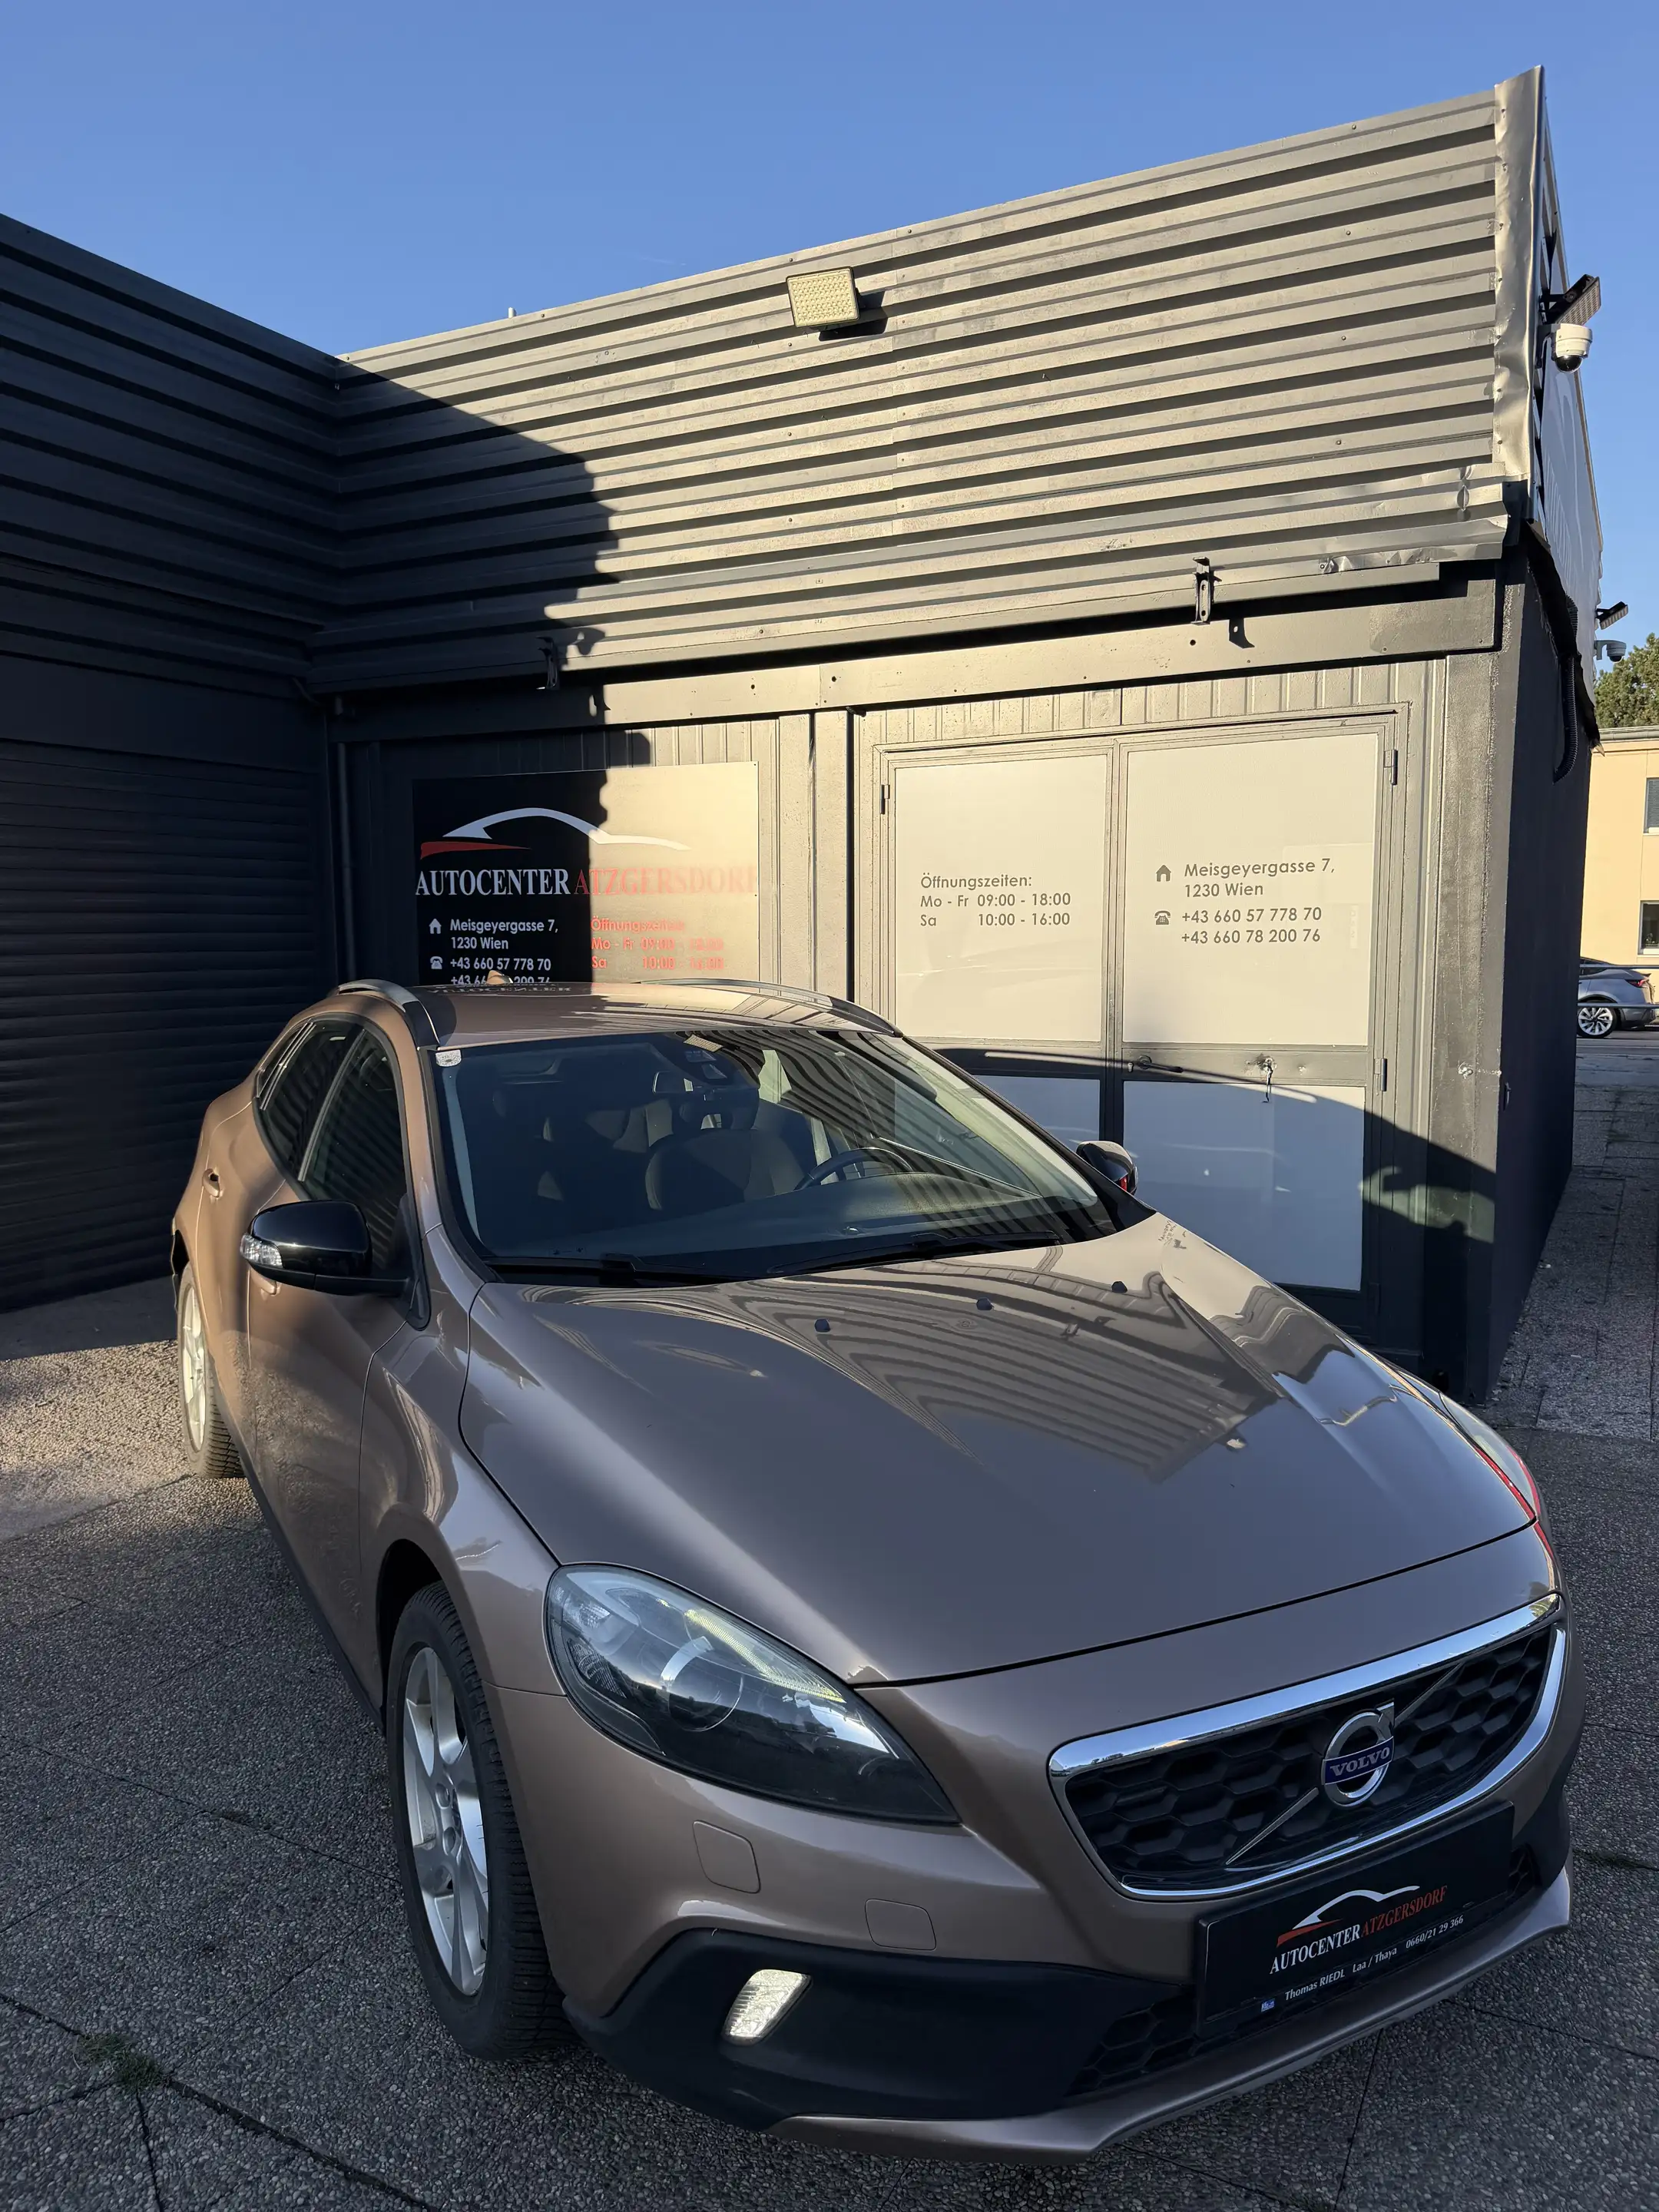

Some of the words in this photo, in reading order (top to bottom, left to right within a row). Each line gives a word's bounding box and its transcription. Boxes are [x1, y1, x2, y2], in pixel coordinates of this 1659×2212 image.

[1184, 862, 1316, 879] Meisgeyergasse
[1321, 858, 1335, 873] 7,
[415, 869, 571, 896] AUTOCENTER
[921, 873, 1032, 891] Öffnungszeiten:
[1184, 884, 1220, 897] 1230
[1225, 882, 1263, 896] Wien
[920, 896, 942, 907] Mo
[958, 895, 969, 907] Fr
[977, 894, 1015, 906] 09:00
[1032, 892, 1071, 906] 18:00
[920, 914, 937, 926] Sa
[979, 913, 1015, 926] 10:00
[1032, 912, 1070, 926] 16:00
[1182, 910, 1209, 923] +43
[1214, 909, 1241, 922] 660
[1246, 909, 1264, 922] 57
[1270, 908, 1297, 922] 778
[1303, 907, 1322, 921] 70
[449, 919, 545, 934] Meisgeyergasse
[548, 919, 558, 932] 7,
[451, 937, 477, 949] 1230
[480, 937, 508, 949] Wien
[591, 937, 611, 950] Mo
[623, 937, 634, 950] Fr
[641, 937, 675, 951] 09:00
[1181, 931, 1208, 944] +43
[1214, 930, 1240, 943] 660
[1246, 929, 1264, 943] 78
[1269, 929, 1297, 942] 200
[1303, 929, 1320, 942] 76
[450, 957, 470, 969] +43
[474, 958, 494, 970] 660
[497, 959, 510, 969] 57
[514, 959, 534, 971] 778
[538, 959, 551, 971] 70
[591, 956, 607, 969] Sa
[642, 956, 676, 969] 10:00
[1330, 1747, 1390, 1777] VOLVO
[1270, 1924, 1360, 1974] AUTOCENTER
[1360, 1886, 1448, 1938] ATZGERSDORF
[1285, 1982, 1317, 2000] Thomas
[1320, 1969, 1345, 1986] RIEDL
[1353, 1962, 1366, 1972] Laa
[1375, 1947, 1397, 1964] Thaya
[1406, 1928, 1436, 1949] 0660/21
[1439, 1922, 1449, 1934] 29
[1449, 1915, 1464, 1929] 366
